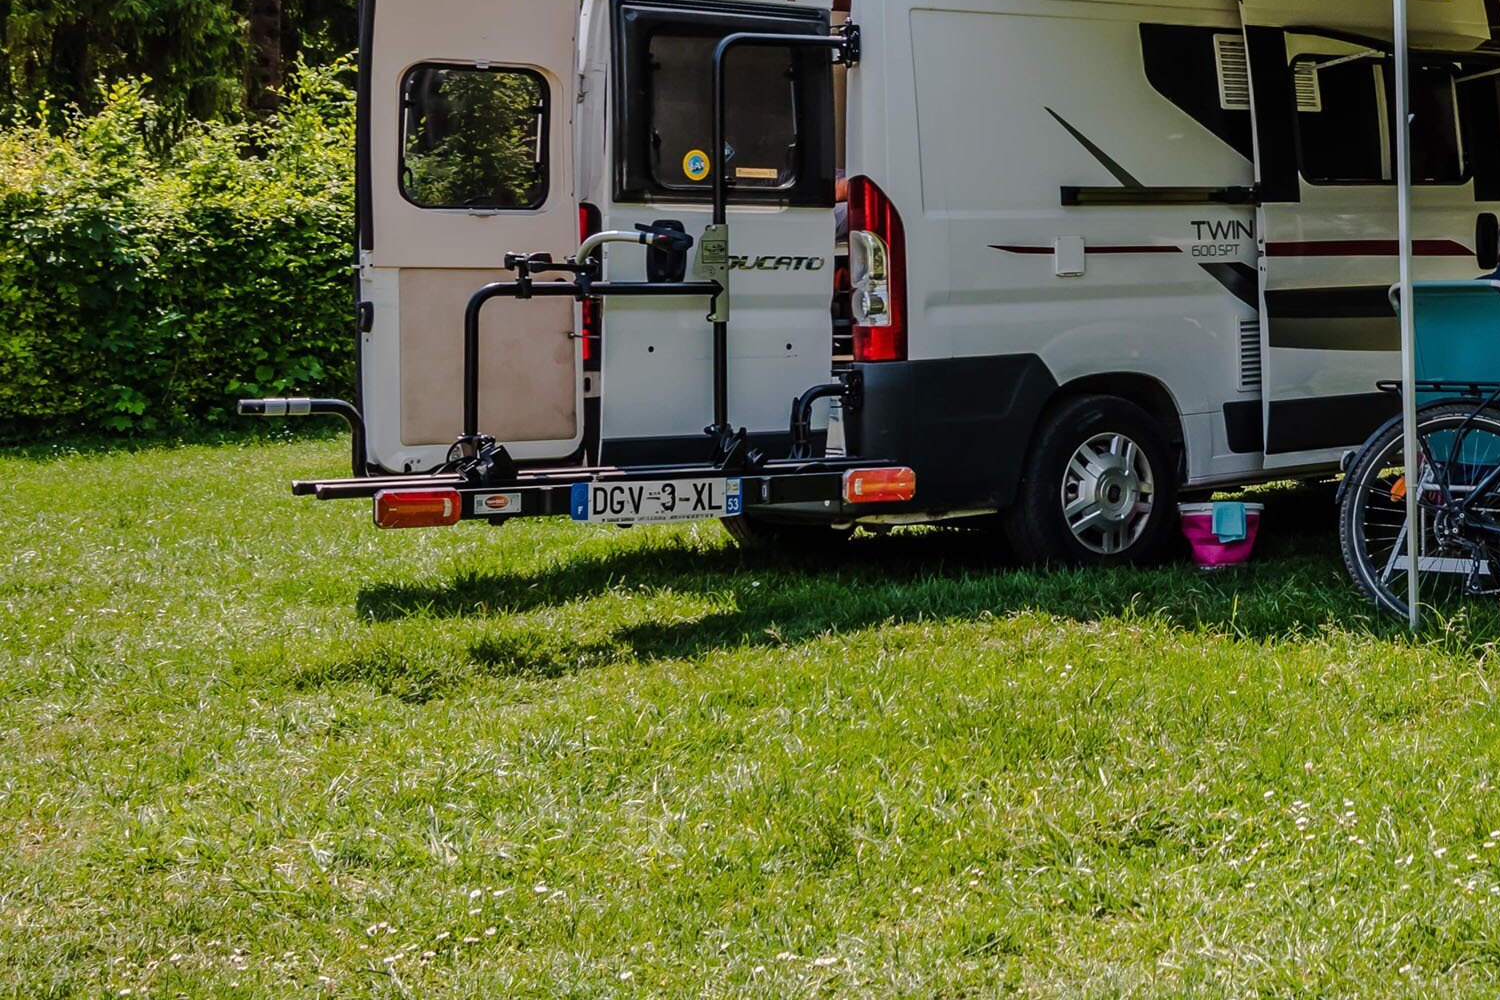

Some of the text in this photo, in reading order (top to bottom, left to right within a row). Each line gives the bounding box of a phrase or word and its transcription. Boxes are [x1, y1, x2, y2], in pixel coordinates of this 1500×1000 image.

[1190, 220, 1253, 241] TWIN
[1191, 243, 1240, 257] 600 SPT
[727, 497, 740, 511] 53
